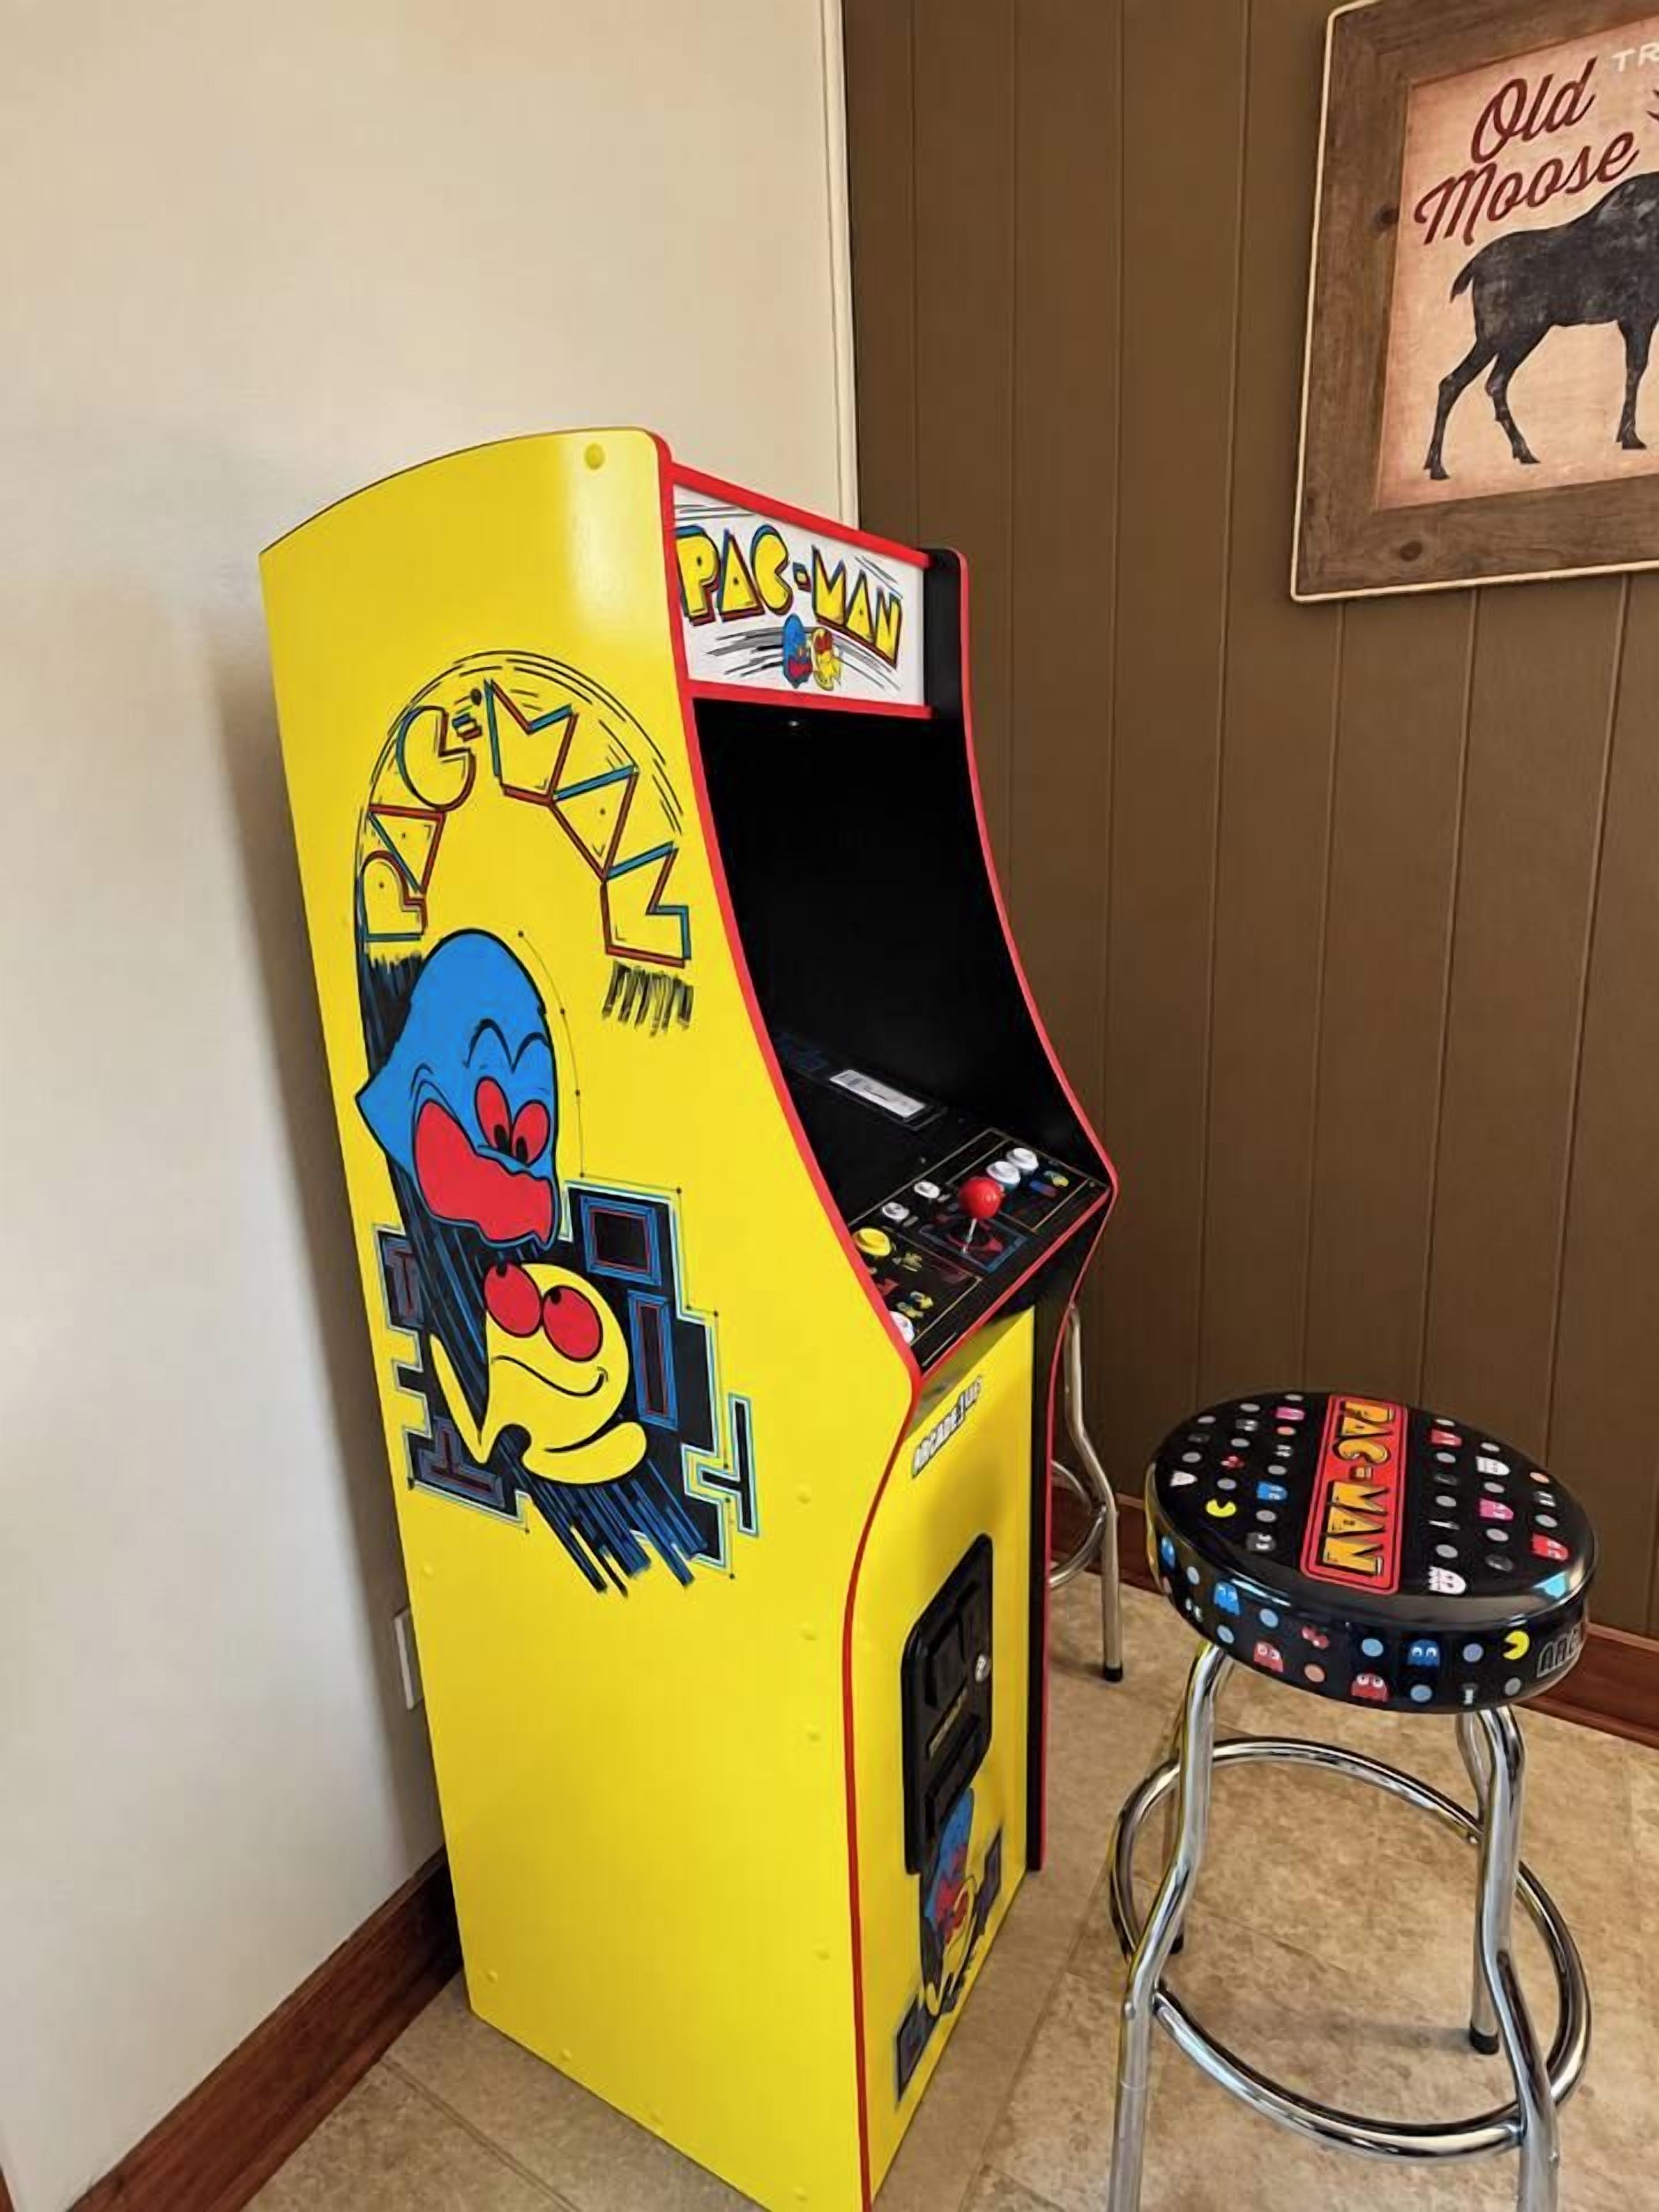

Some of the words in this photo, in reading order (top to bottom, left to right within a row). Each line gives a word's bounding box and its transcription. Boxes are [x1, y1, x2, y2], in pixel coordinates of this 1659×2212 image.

[1471, 56, 1598, 164] Old
[1414, 131, 1640, 246] Moose
[675, 523, 903, 669] PAC-MAN
[1315, 1400, 1395, 1577] PAC-MAN
